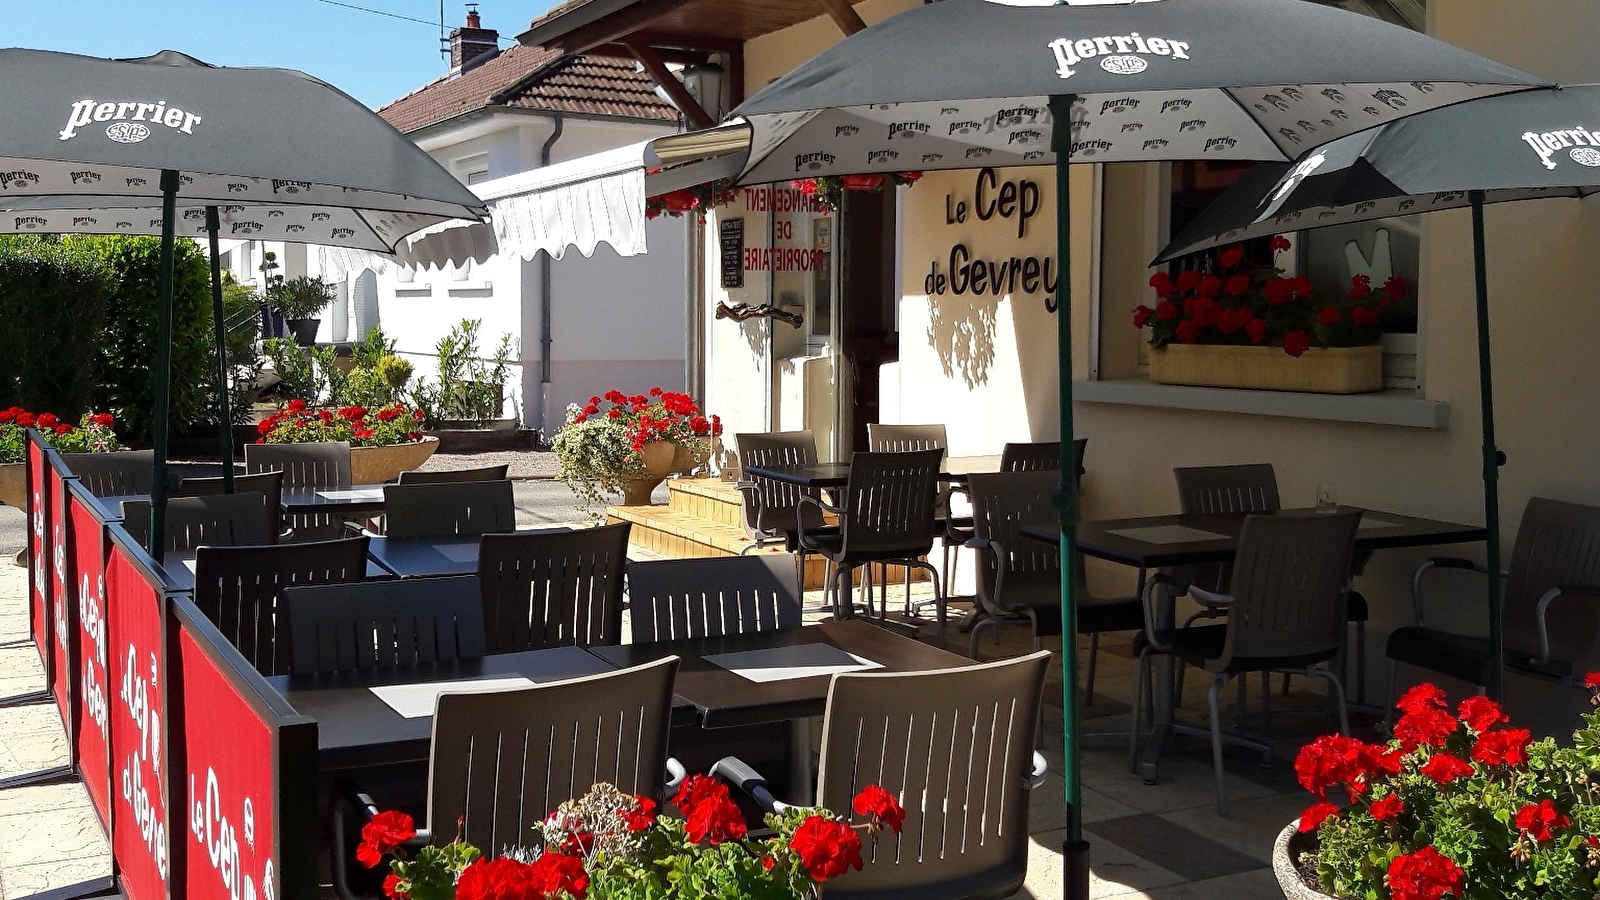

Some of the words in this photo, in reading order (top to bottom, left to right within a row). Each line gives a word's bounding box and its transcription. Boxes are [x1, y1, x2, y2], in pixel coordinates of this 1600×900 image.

[945, 194, 967, 225] Le
[975, 167, 1040, 240] Cep
[925, 260, 946, 296] de
[950, 244, 1058, 314] Gevrey
[191, 773, 204, 843] Le
